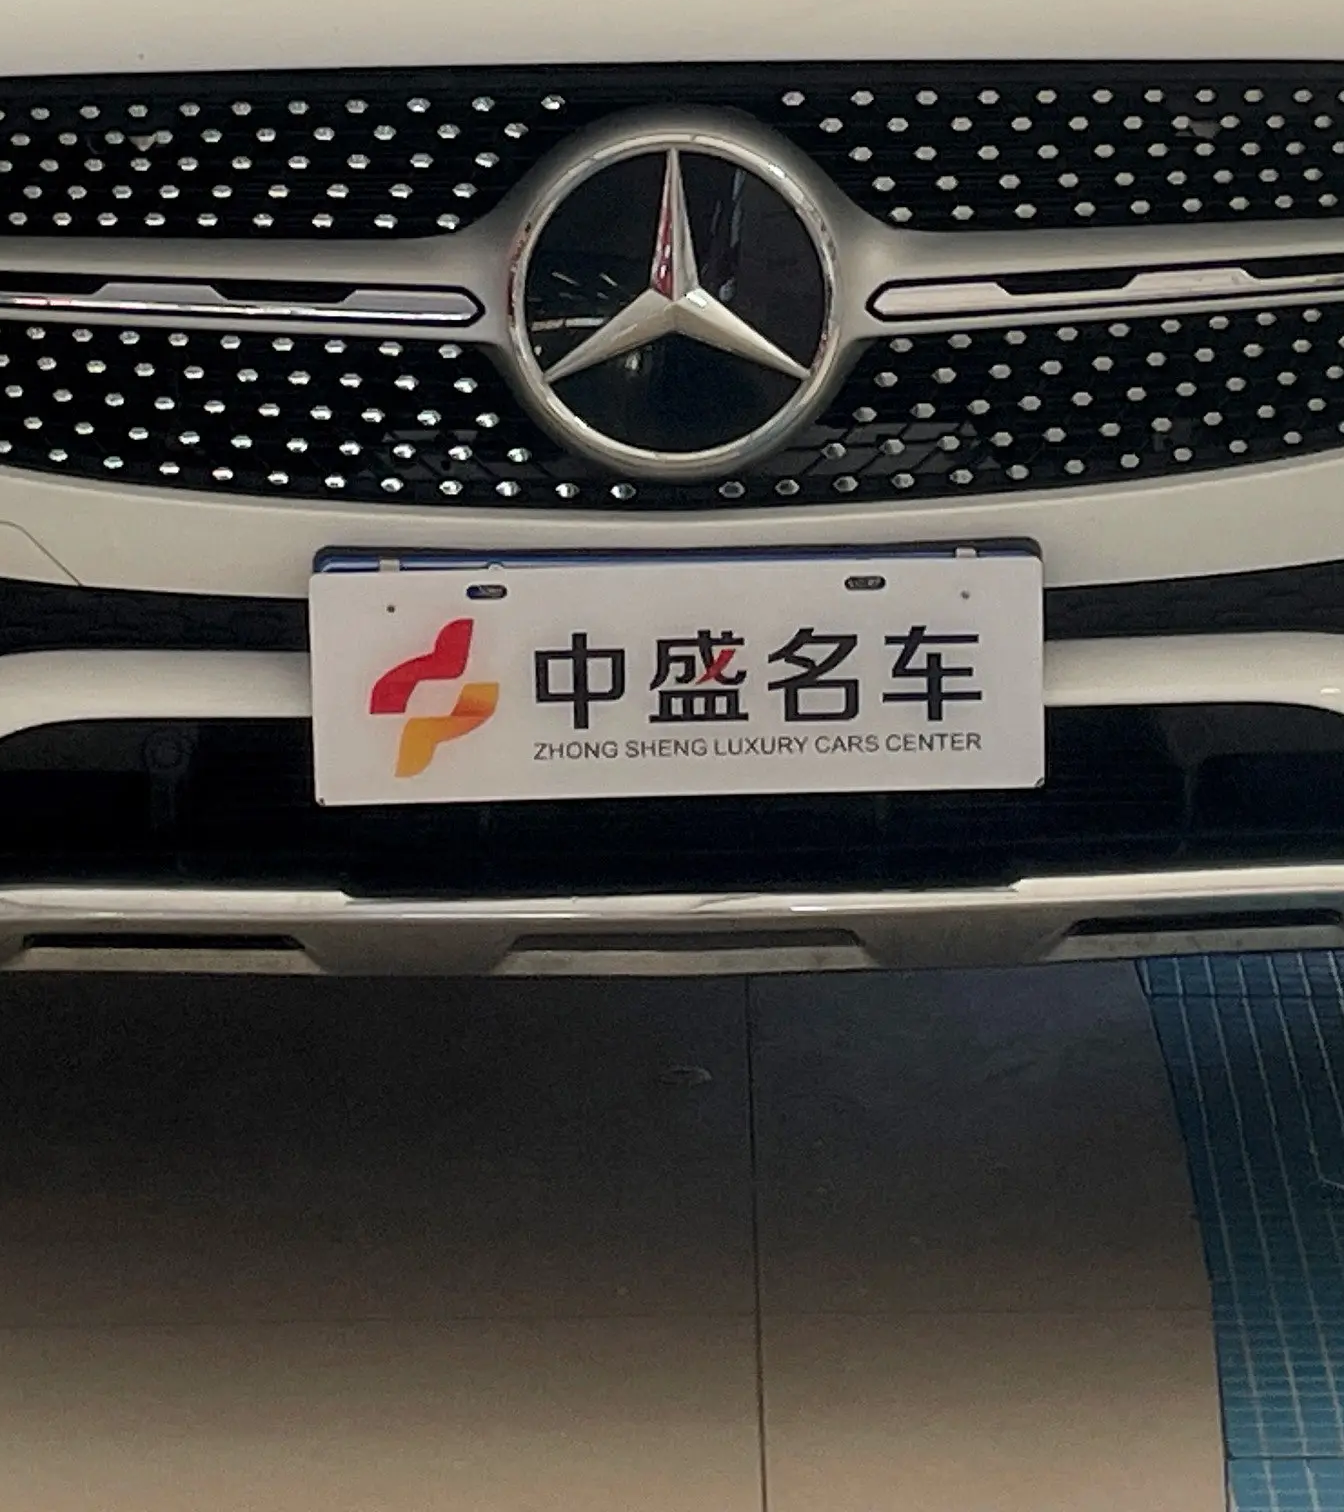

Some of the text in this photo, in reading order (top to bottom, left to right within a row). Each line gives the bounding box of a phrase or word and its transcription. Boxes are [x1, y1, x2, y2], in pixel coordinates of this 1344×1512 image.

[533, 624, 983, 730] 中盛名车
[533, 732, 982, 761] ZHONG SHENG LUXURY CARS CENTER
